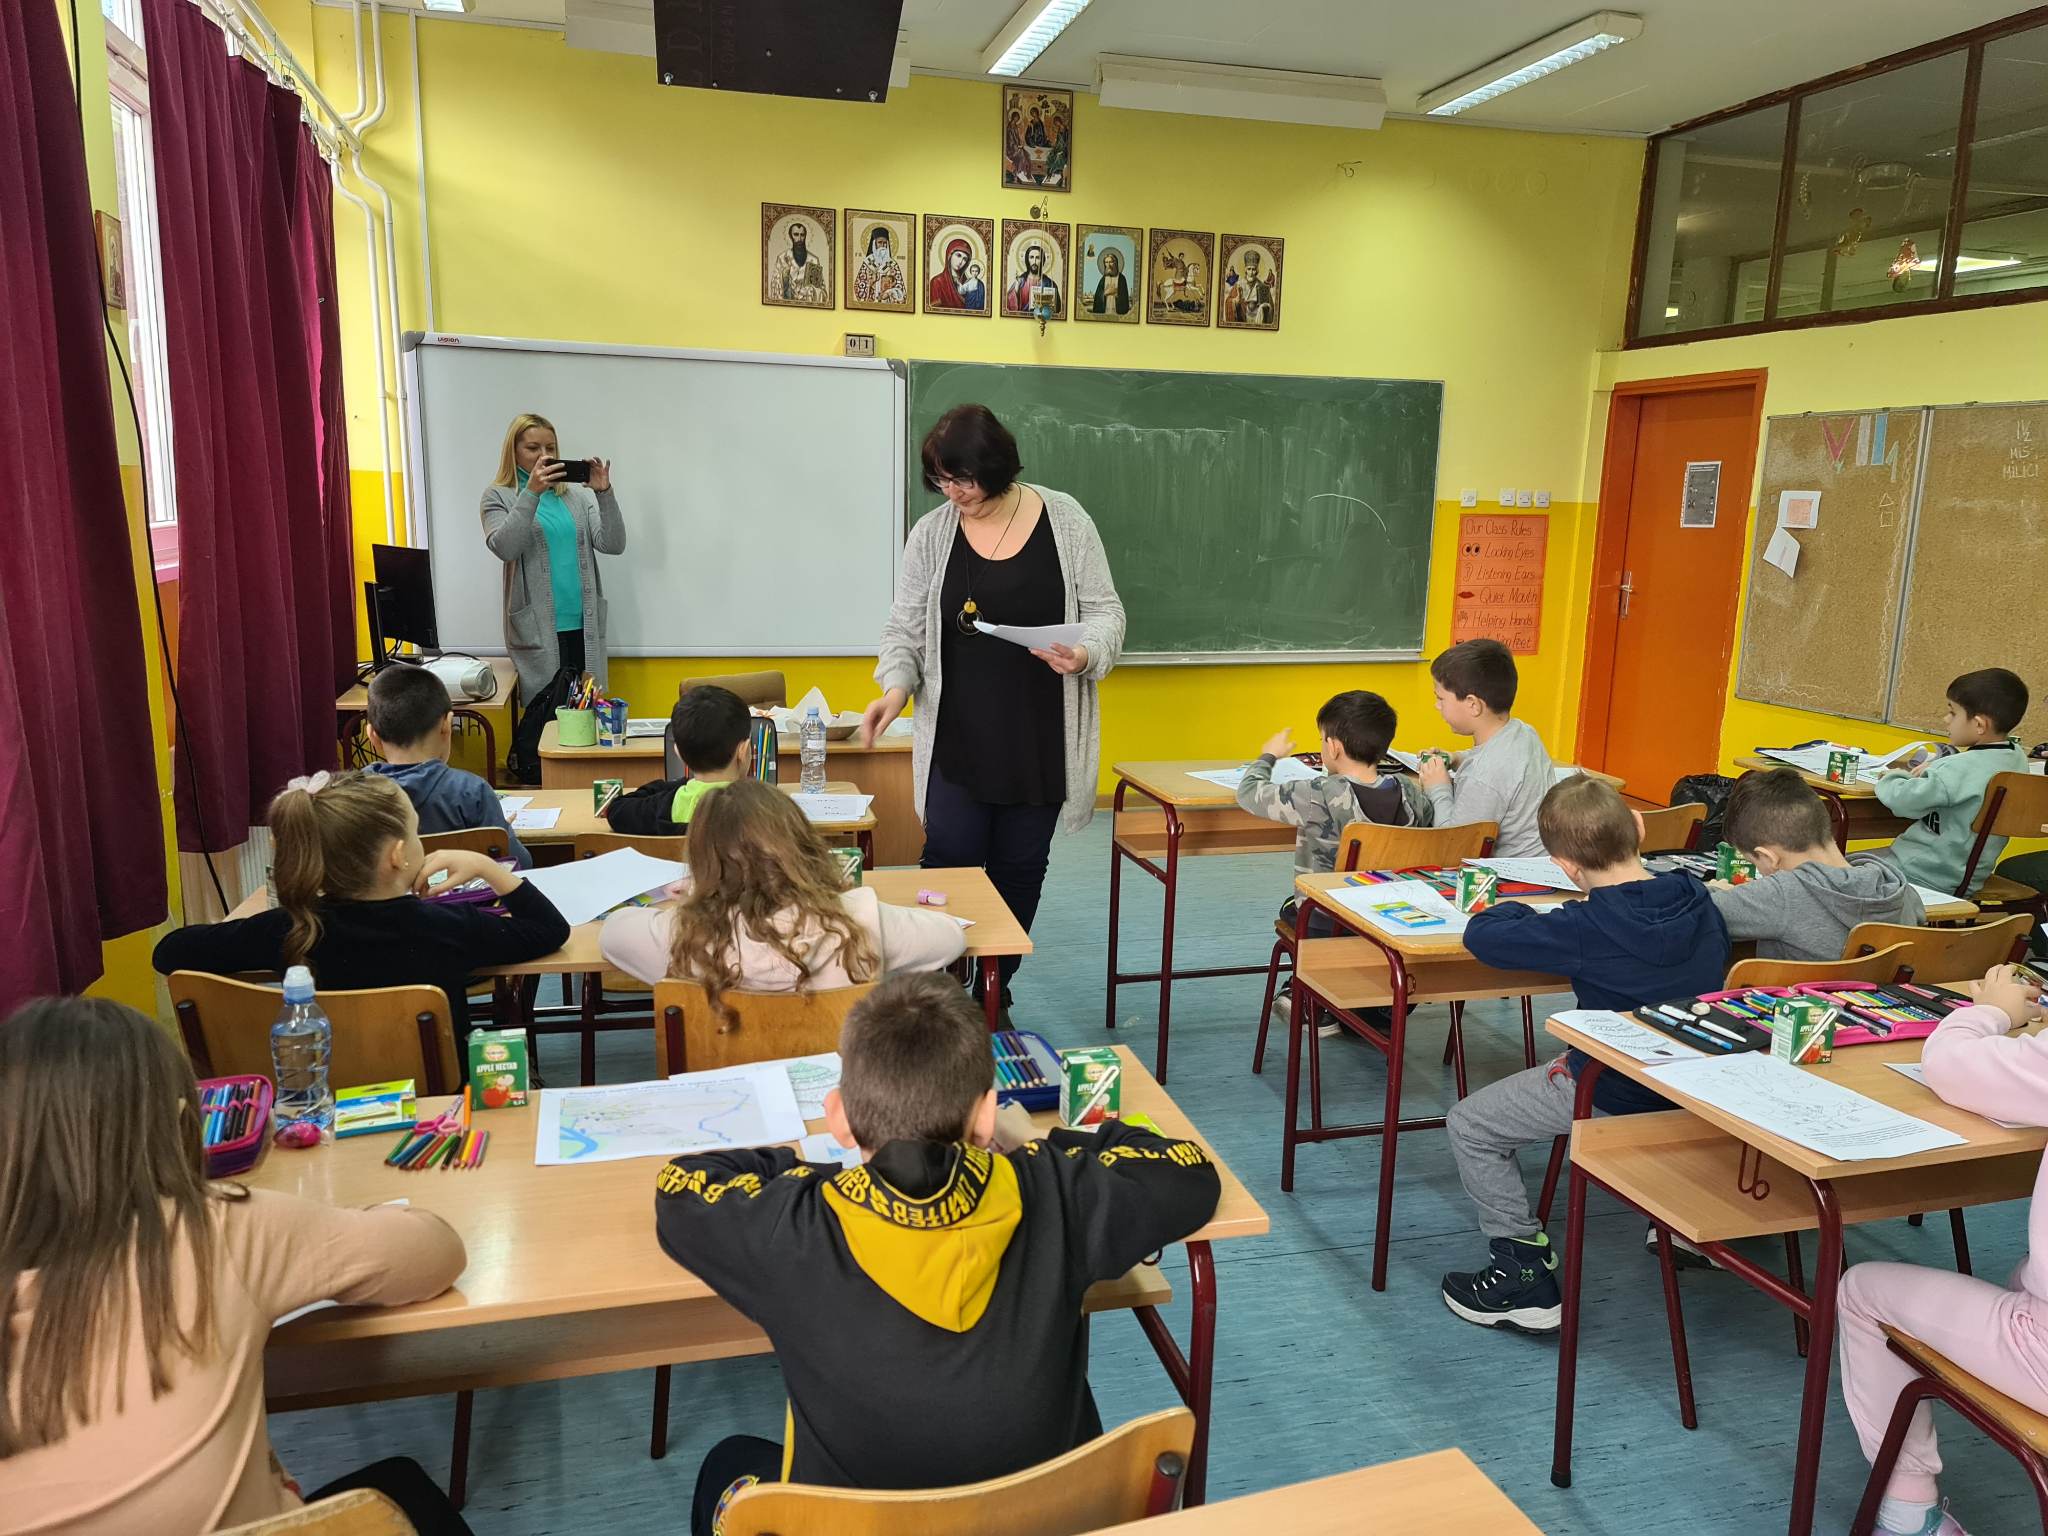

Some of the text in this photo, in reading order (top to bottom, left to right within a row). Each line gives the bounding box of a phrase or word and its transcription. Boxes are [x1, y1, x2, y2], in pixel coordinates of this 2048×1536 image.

[1465, 518, 1532, 536] Our Class Rules
[1484, 542, 1535, 560] Looking Eyes
[1476, 562, 1536, 583] Listening Ears
[1480, 586, 1537, 605] Quiet Mouth
[1472, 610, 1533, 629] Helping Hands
[1513, 632, 1531, 649] Feet
[476, 1062, 518, 1073] APPLE NECTAR
